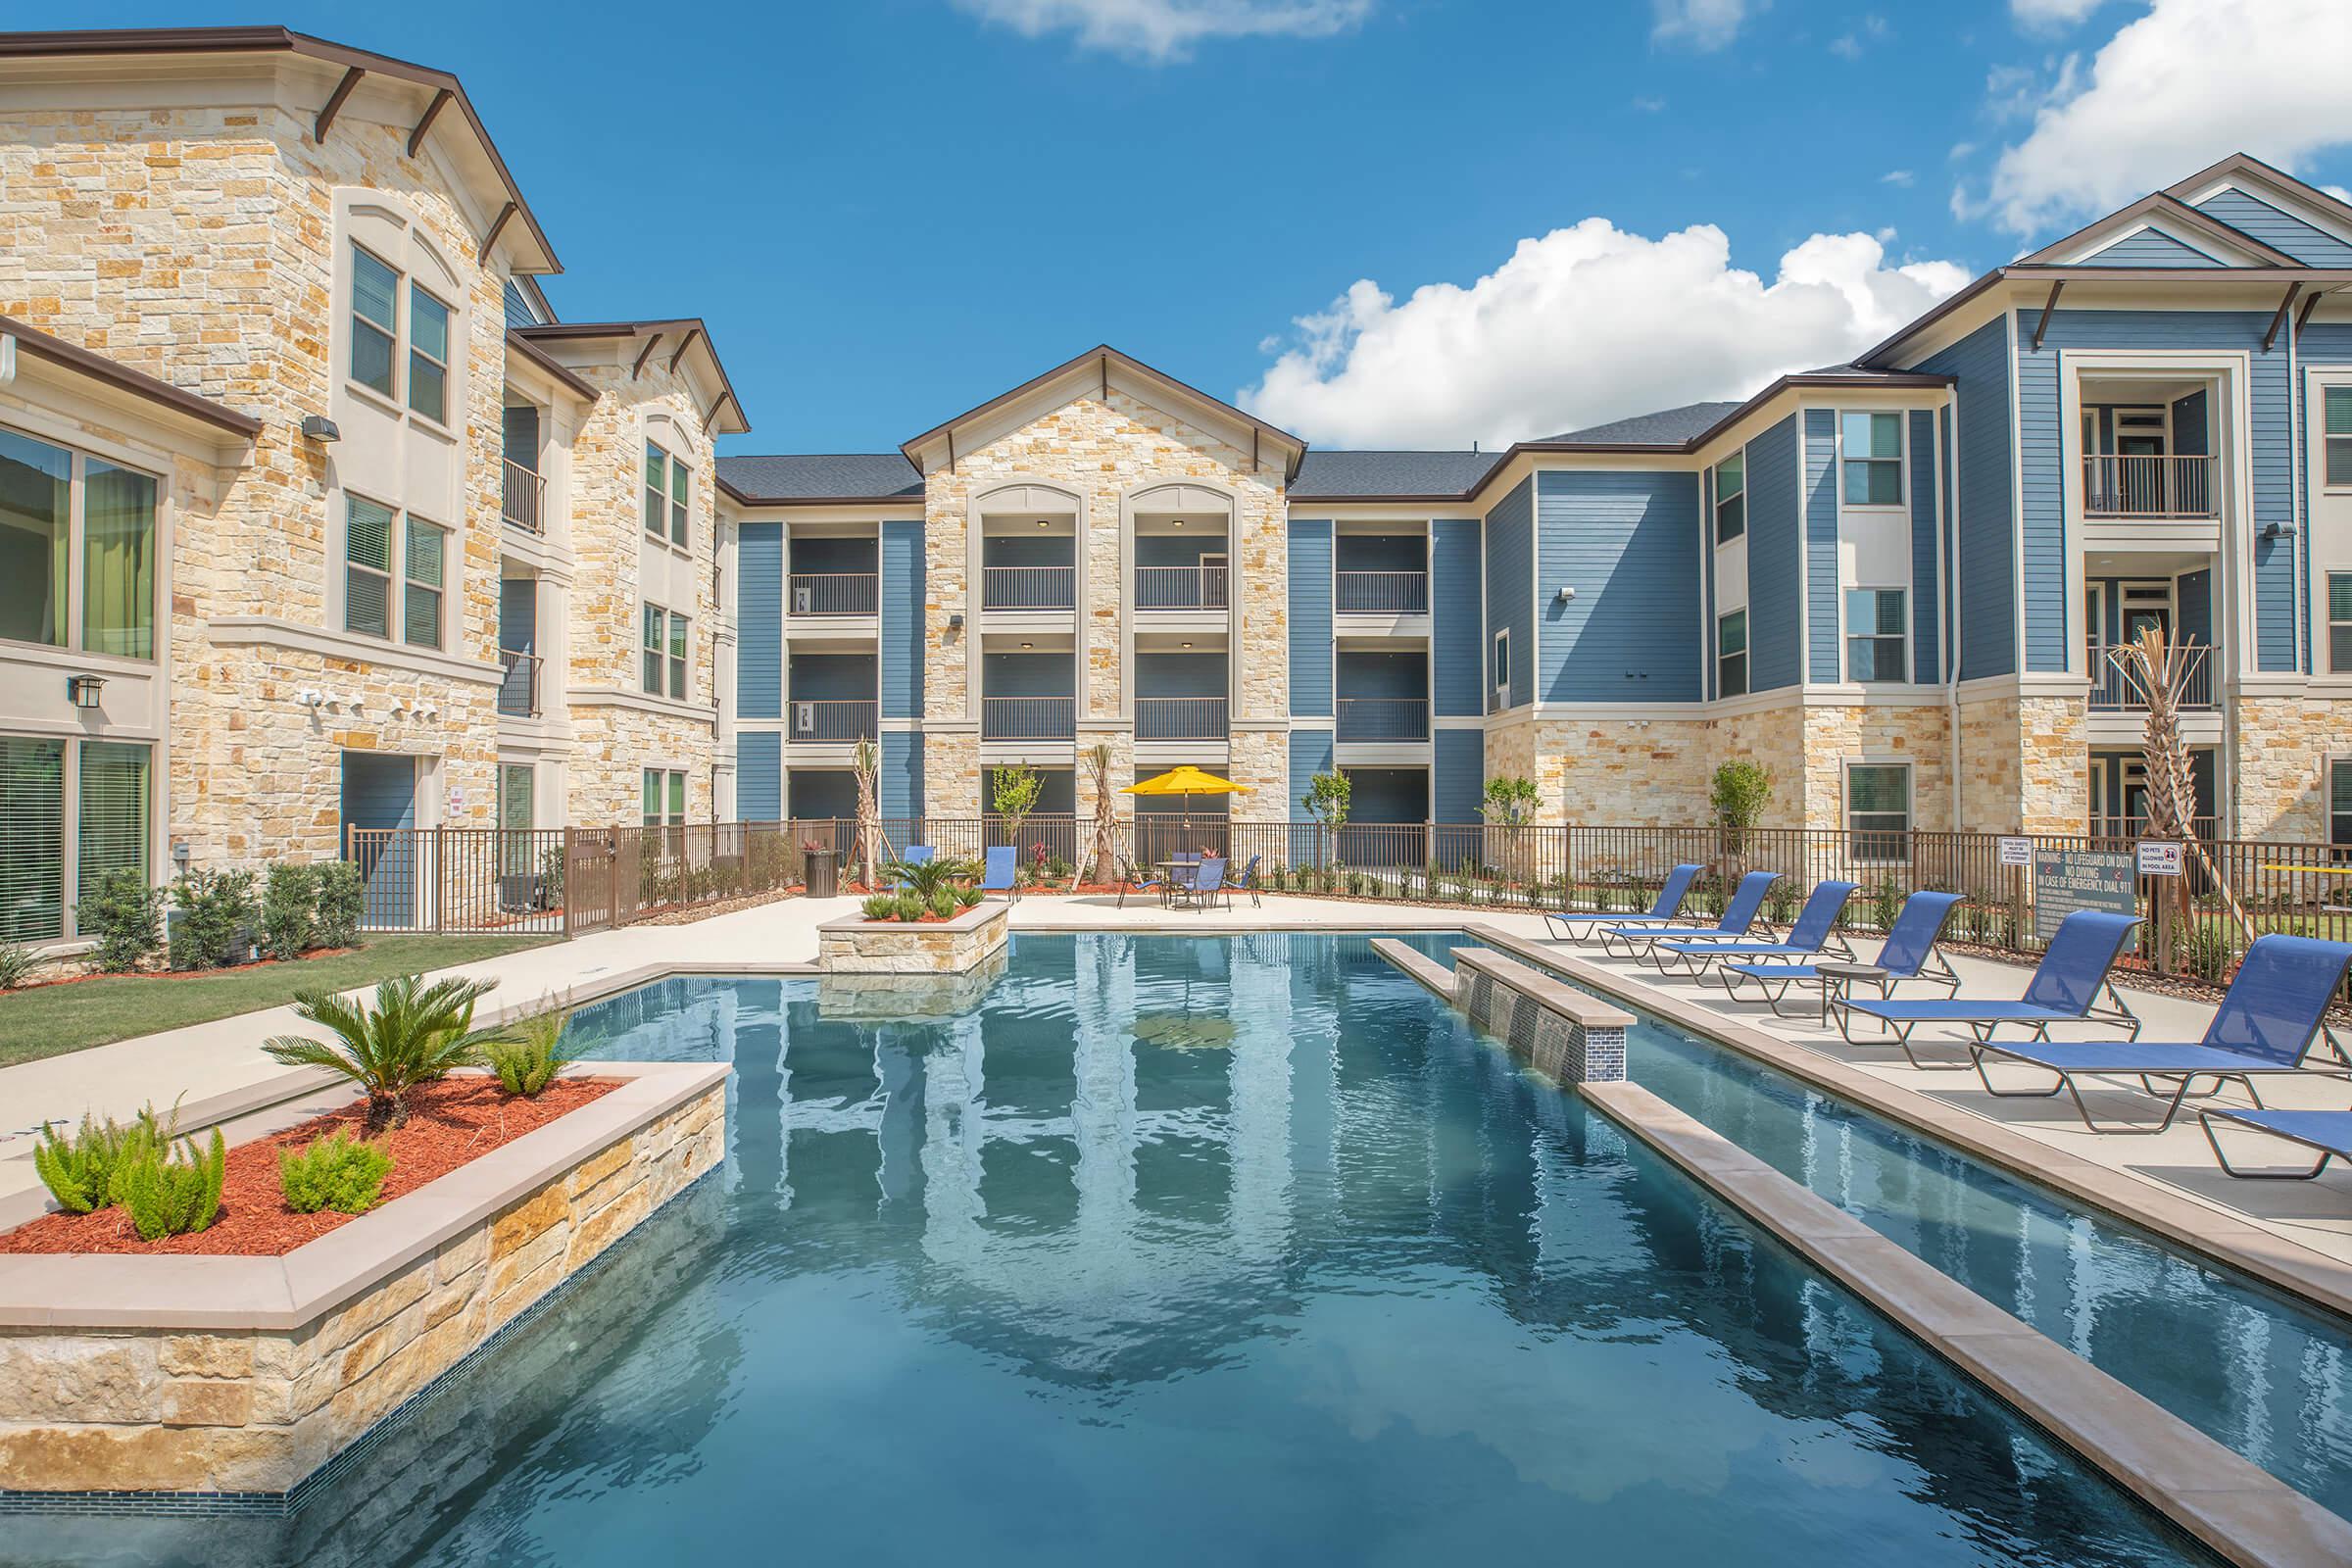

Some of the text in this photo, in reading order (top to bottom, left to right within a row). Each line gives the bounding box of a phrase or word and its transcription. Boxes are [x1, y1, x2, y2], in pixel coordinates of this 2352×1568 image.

[2038, 851, 2061, 863] WARNING
[2065, 853, 2074, 864] NO
[2074, 854, 2105, 867] LIFEGUARD
[2106, 855, 2115, 867] ON
[2116, 856, 2132, 869] DUTY
[2065, 864, 2099, 879] NO DIVING
[2045, 875, 2059, 888] CASE
[2059, 876, 2067, 888] OF
[2068, 877, 2103, 893] EMERGENCY,
[2104, 879, 2119, 894] DIAL
[2120, 881, 2132, 894] 911
